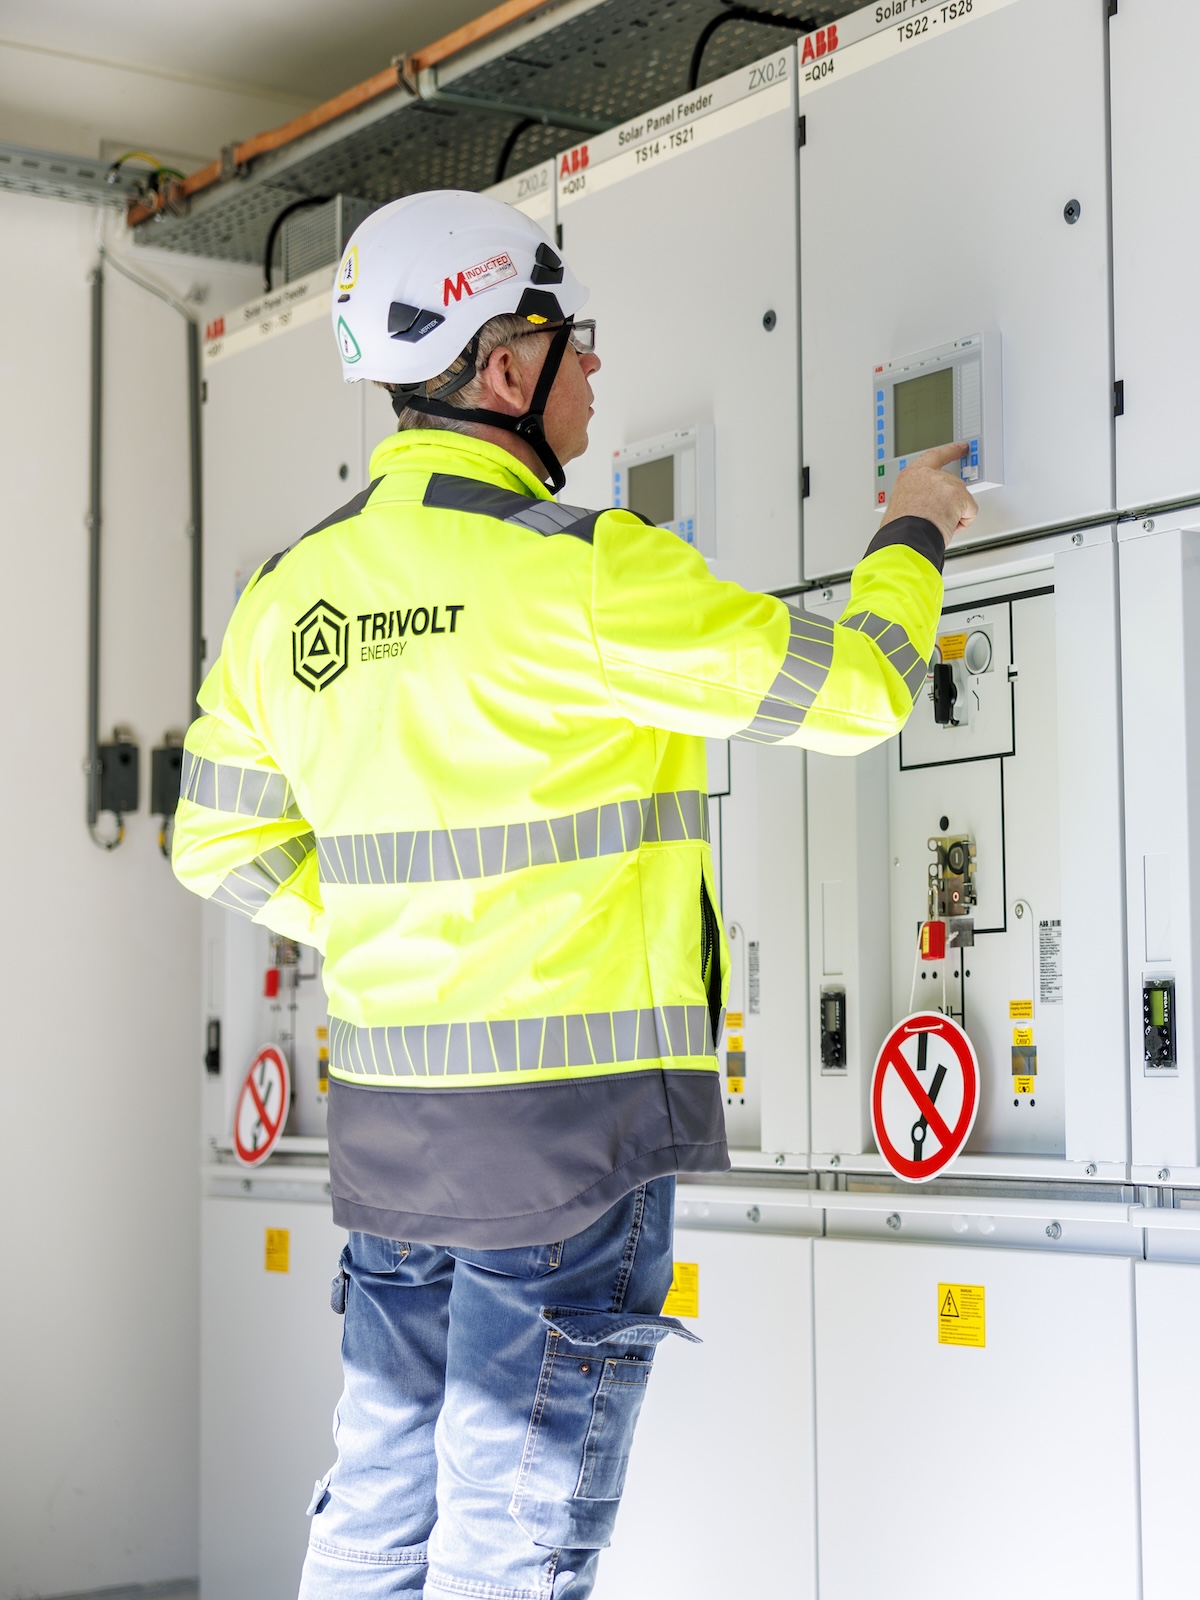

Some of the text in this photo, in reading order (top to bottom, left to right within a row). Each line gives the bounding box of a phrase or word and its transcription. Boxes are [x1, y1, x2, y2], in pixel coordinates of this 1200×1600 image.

[875, 0, 908, 23] Solar
[897, 16, 928, 42] TS22
[941, 0, 973, 23] TS28
[801, 24, 839, 65] ABB
[748, 57, 786, 90] ZX0.2
[805, 58, 834, 82] =Q04
[618, 93, 713, 146] Solar Panel Feeder
[635, 143, 660, 164] TS14
[669, 127, 694, 150] TS21
[559, 144, 590, 181] ABB
[464, 255, 509, 280] INDUCTED
[204, 315, 226, 343] ABB
[419, 319, 439, 335] VERTEX
[357, 604, 465, 643] TRIVOLT
[360, 641, 408, 662] ENERGY
